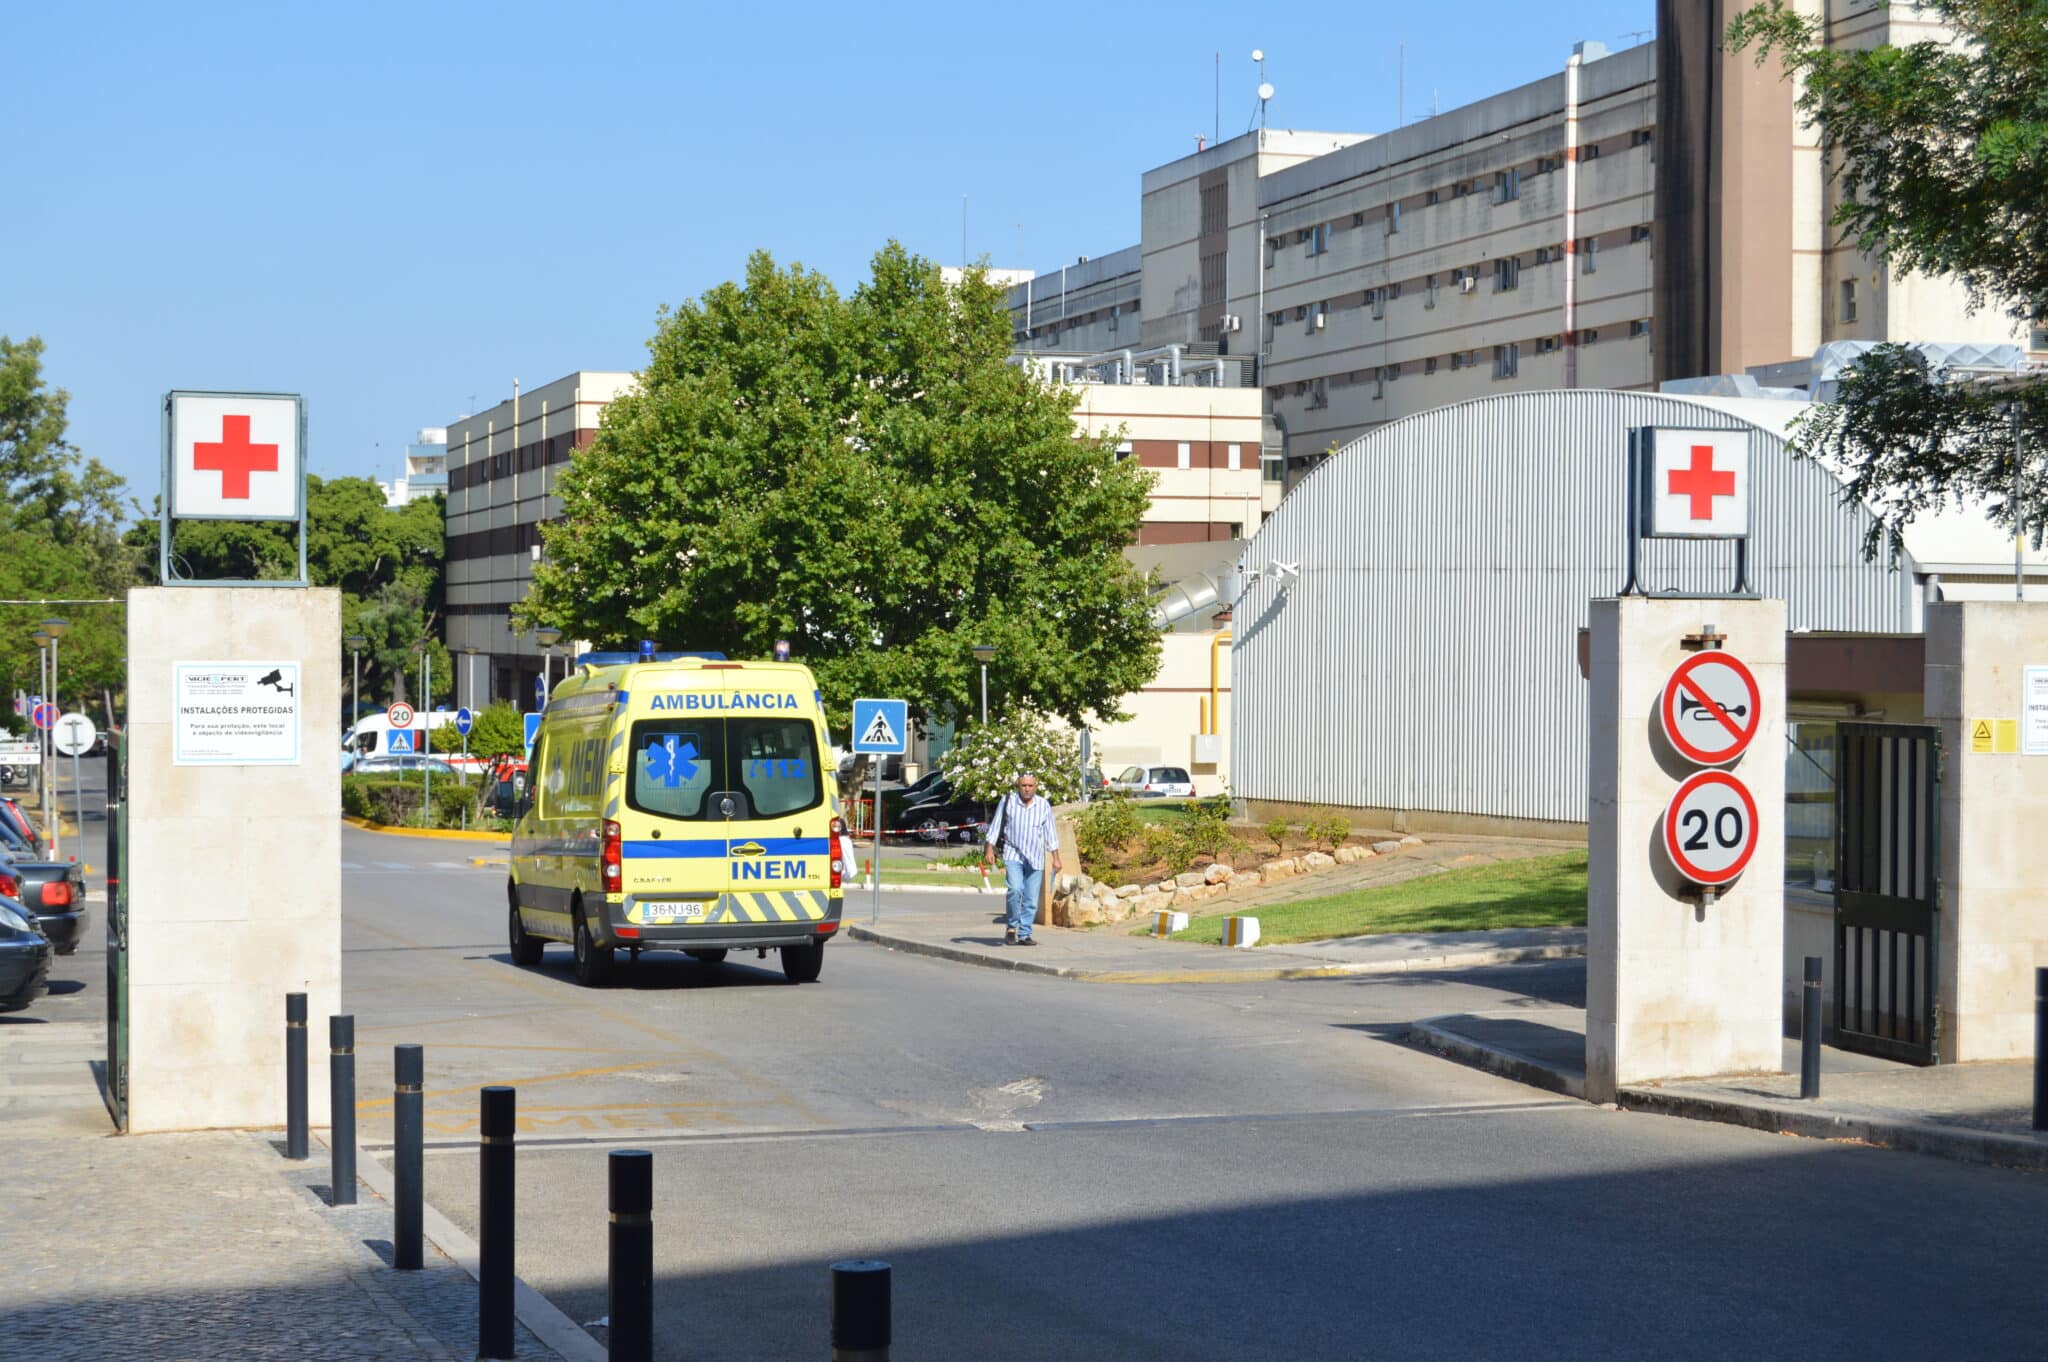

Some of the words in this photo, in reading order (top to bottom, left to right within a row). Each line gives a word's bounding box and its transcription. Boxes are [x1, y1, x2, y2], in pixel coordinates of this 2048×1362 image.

[651, 691, 798, 709] AMBULÂNCIA
[181, 705, 238, 715] INSTALAÇÕES
[241, 706, 293, 714] PROTEGIDAS
[393, 710, 409, 721] 20
[762, 758, 805, 778] 112
[1682, 806, 1743, 851] 20
[732, 860, 806, 880] INEM
